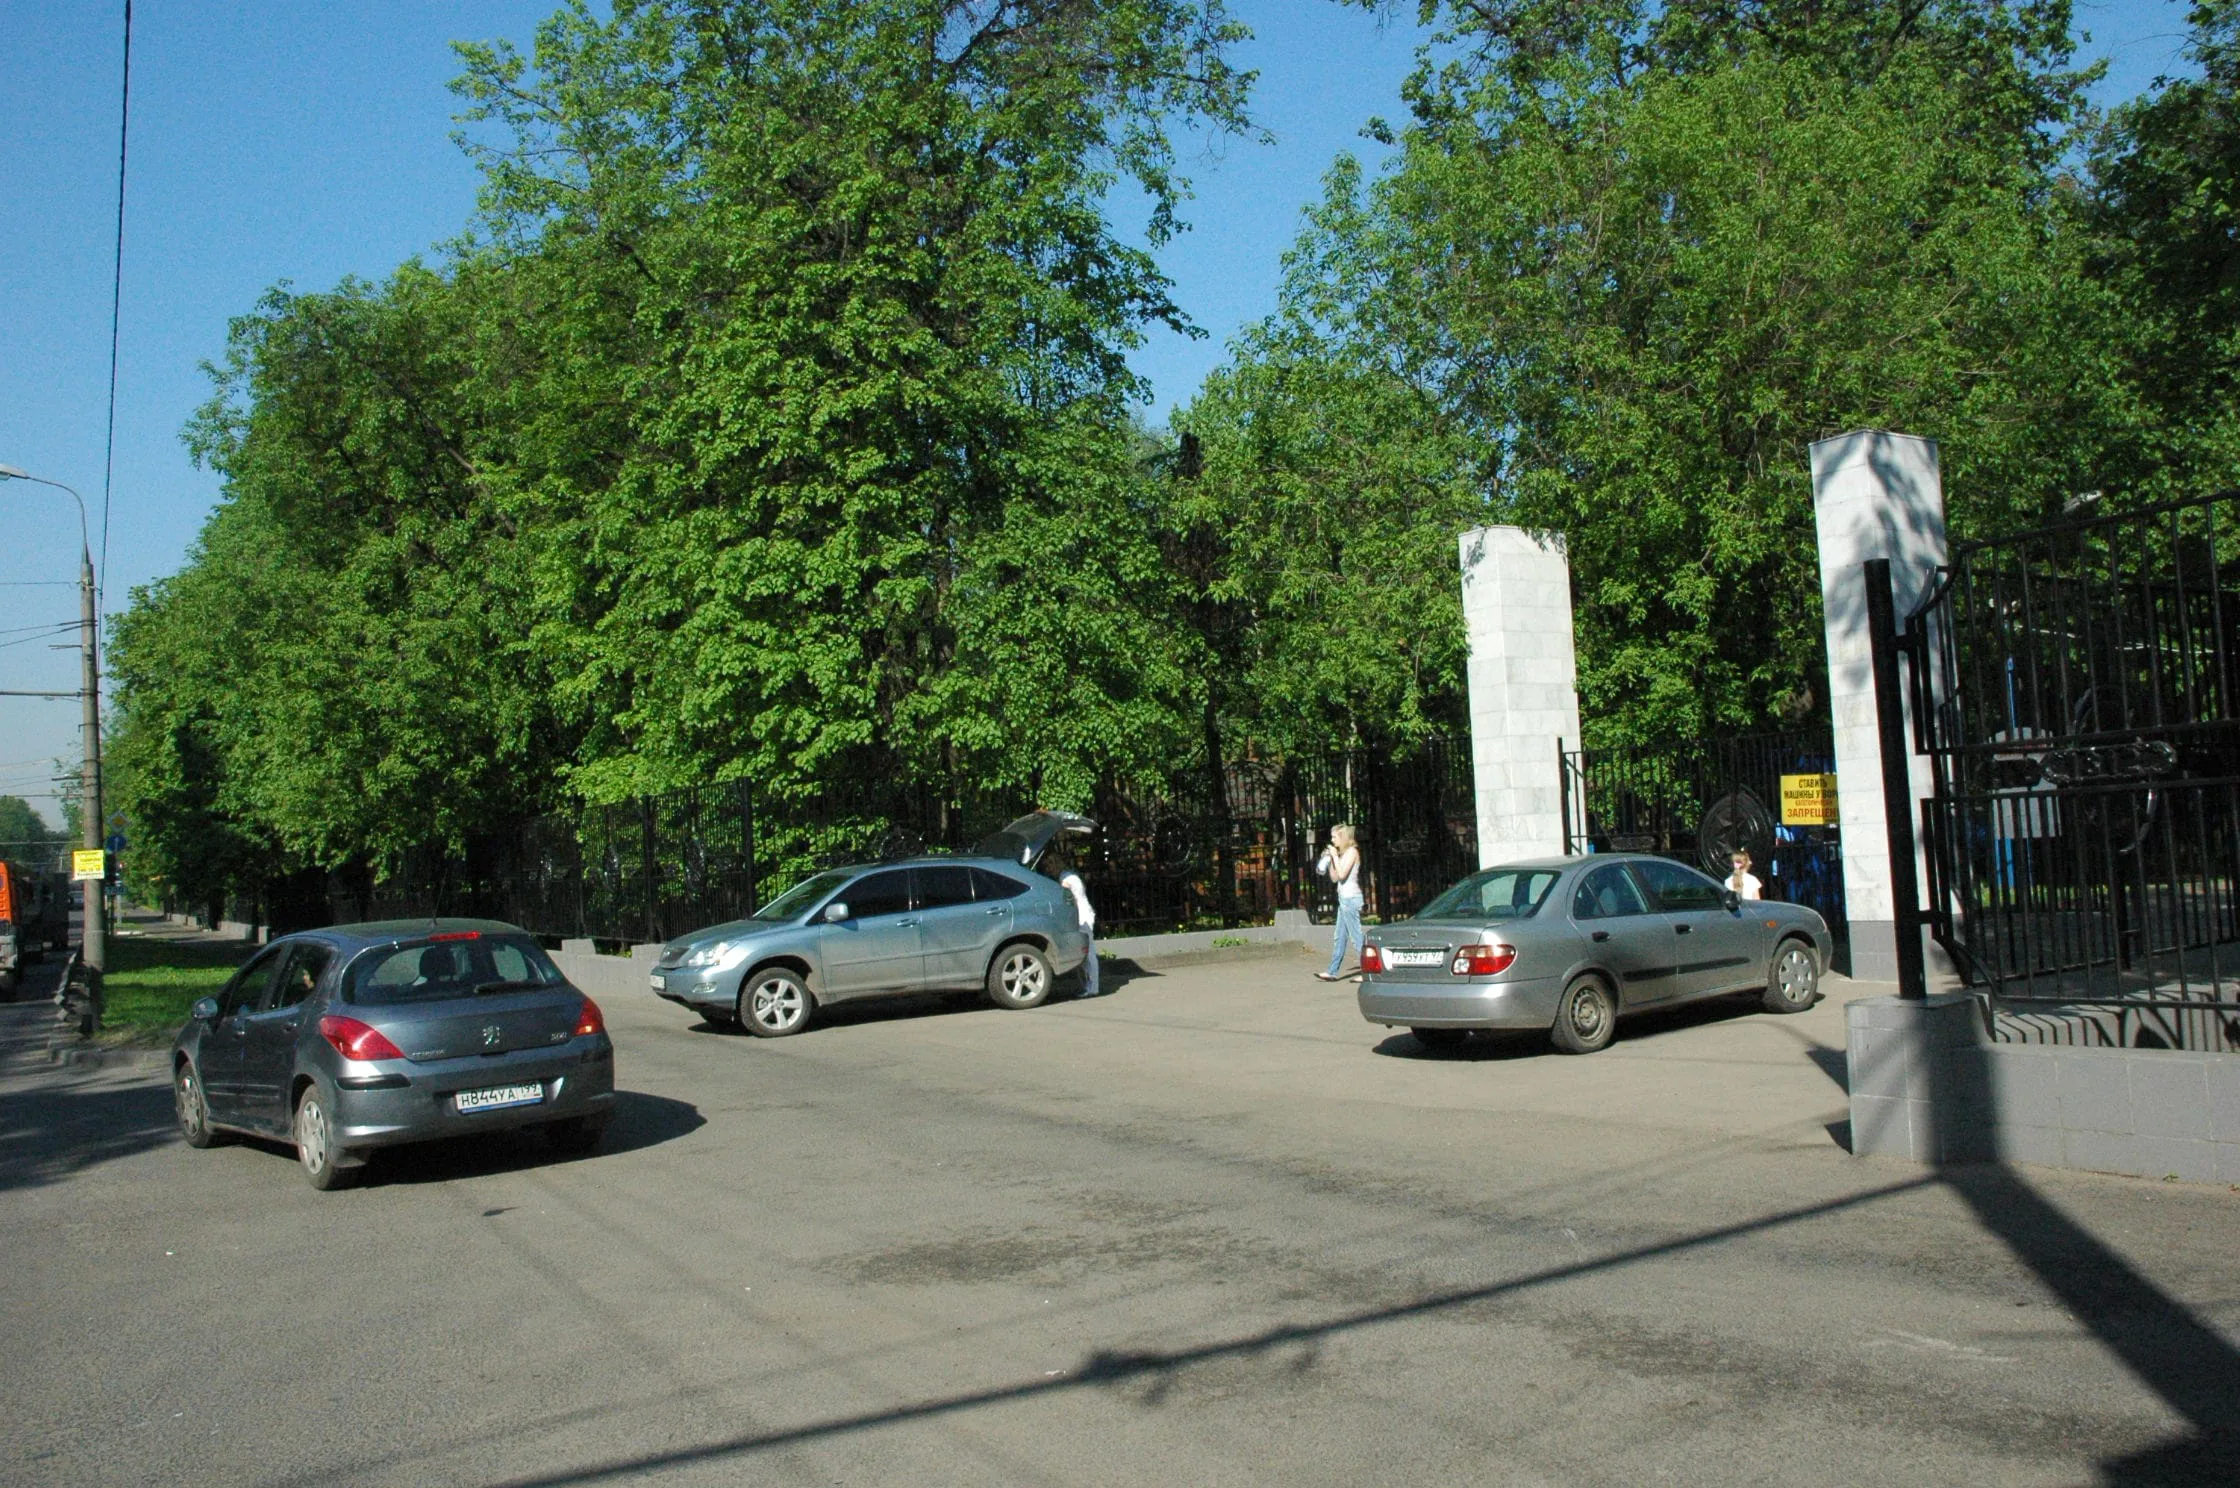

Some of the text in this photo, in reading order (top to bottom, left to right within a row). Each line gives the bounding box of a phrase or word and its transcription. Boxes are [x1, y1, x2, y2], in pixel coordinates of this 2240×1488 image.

[1798, 778, 1828, 788] СТАВИТЬ
[1784, 789, 1815, 799] МАШИНЫ
[1787, 807, 1840, 818] ЗАПРЕЩЕН
